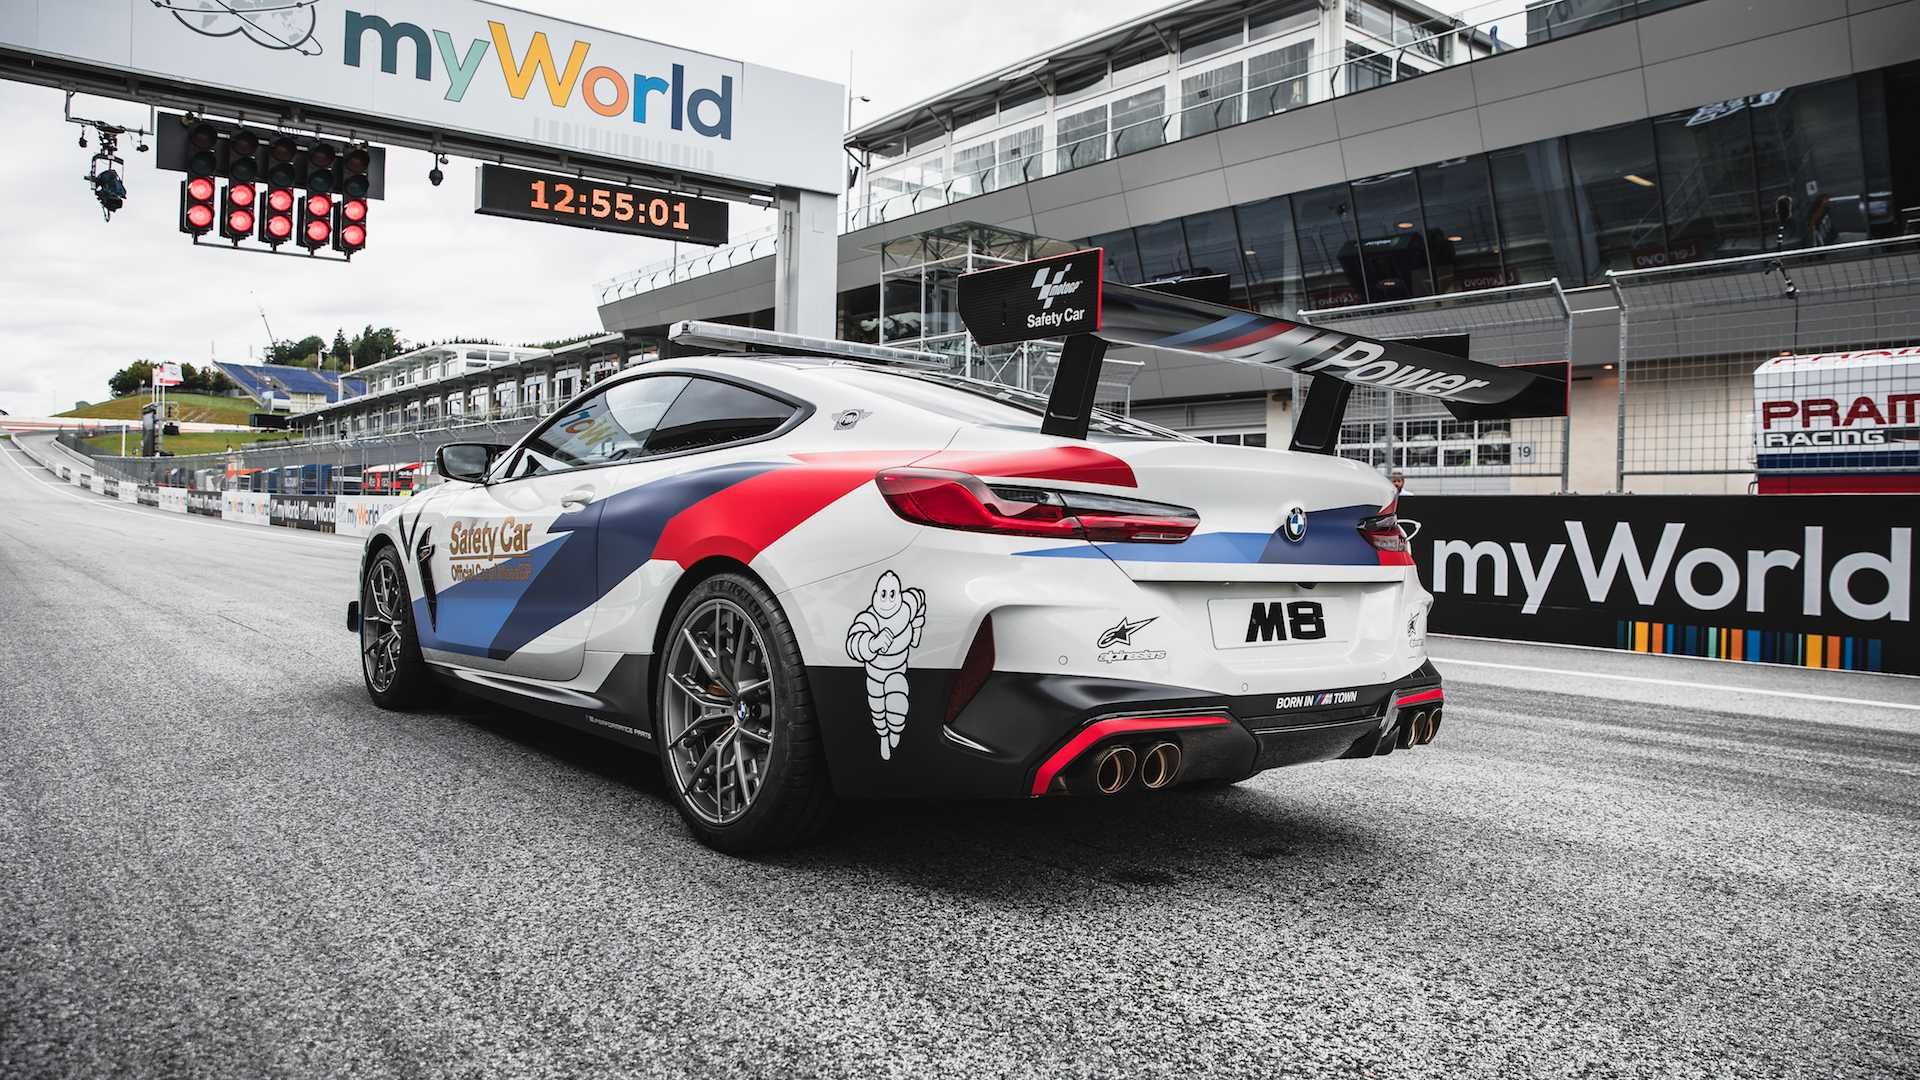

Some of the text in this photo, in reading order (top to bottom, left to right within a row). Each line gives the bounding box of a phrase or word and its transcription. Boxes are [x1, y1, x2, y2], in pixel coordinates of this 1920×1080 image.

[343, 9, 733, 141] myWorld
[530, 179, 690, 231] 12:55:01
[1026, 307, 1086, 328] Safety Car
[1302, 340, 1490, 397] Power
[1517, 446, 1531, 458] 19
[449, 516, 533, 561] Safety Car
[1432, 520, 1912, 622] myWorld
[1245, 600, 1327, 642] M8
[1275, 697, 1302, 709] BORN
[1303, 695, 1315, 707] IN
[1334, 690, 1358, 704] TOWN
